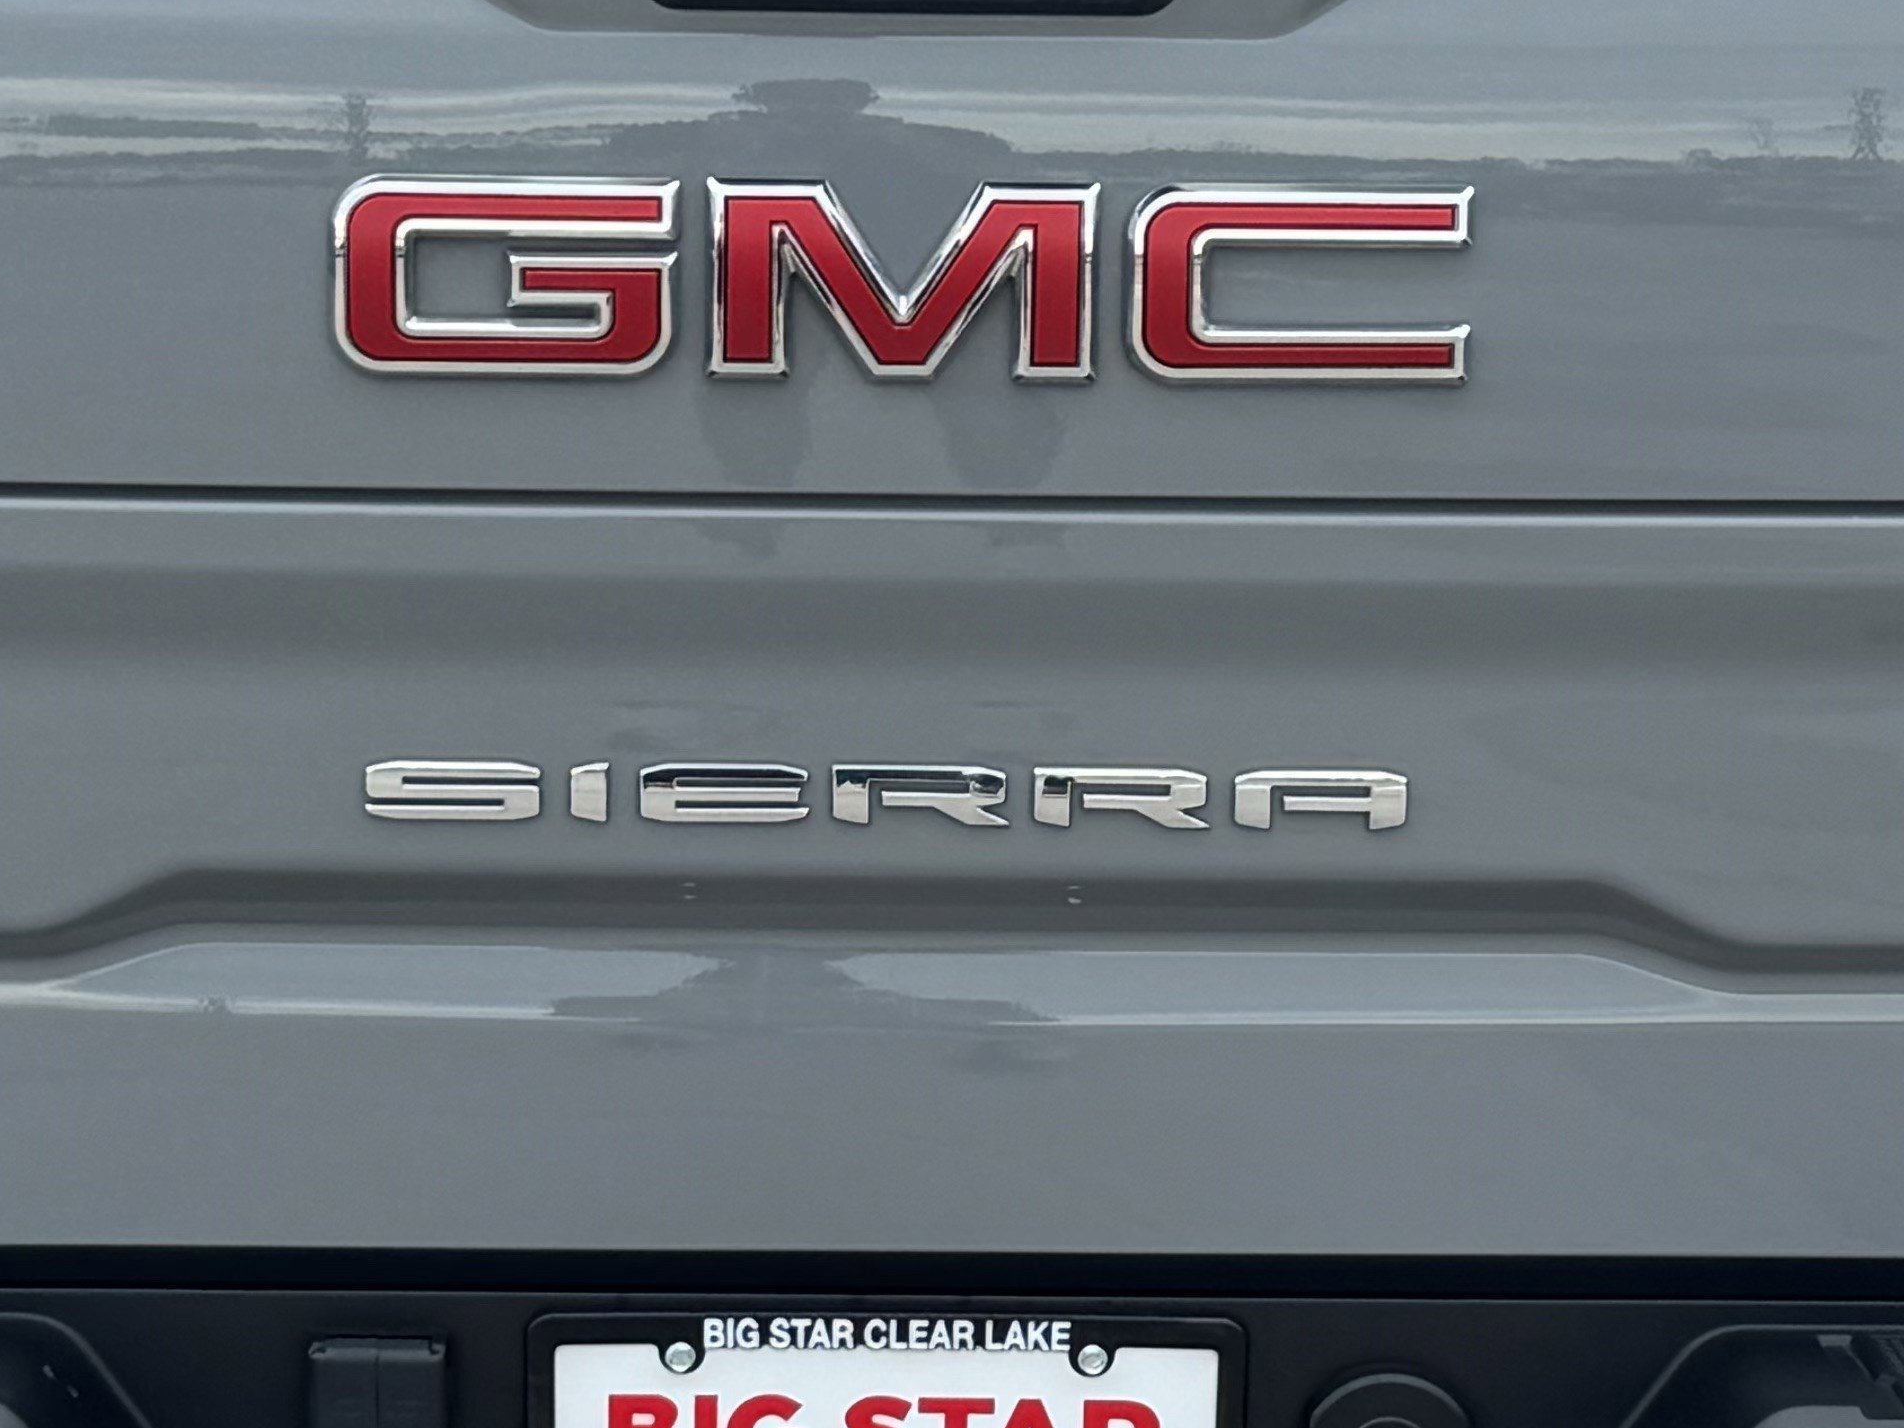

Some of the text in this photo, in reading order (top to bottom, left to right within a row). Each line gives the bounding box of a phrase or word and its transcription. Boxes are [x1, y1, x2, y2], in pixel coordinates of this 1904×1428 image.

[331, 175, 1475, 385] GMC
[365, 760, 1408, 830] SIERRA
[702, 1317, 1072, 1352] BIG STAR CLEAR LAKE
